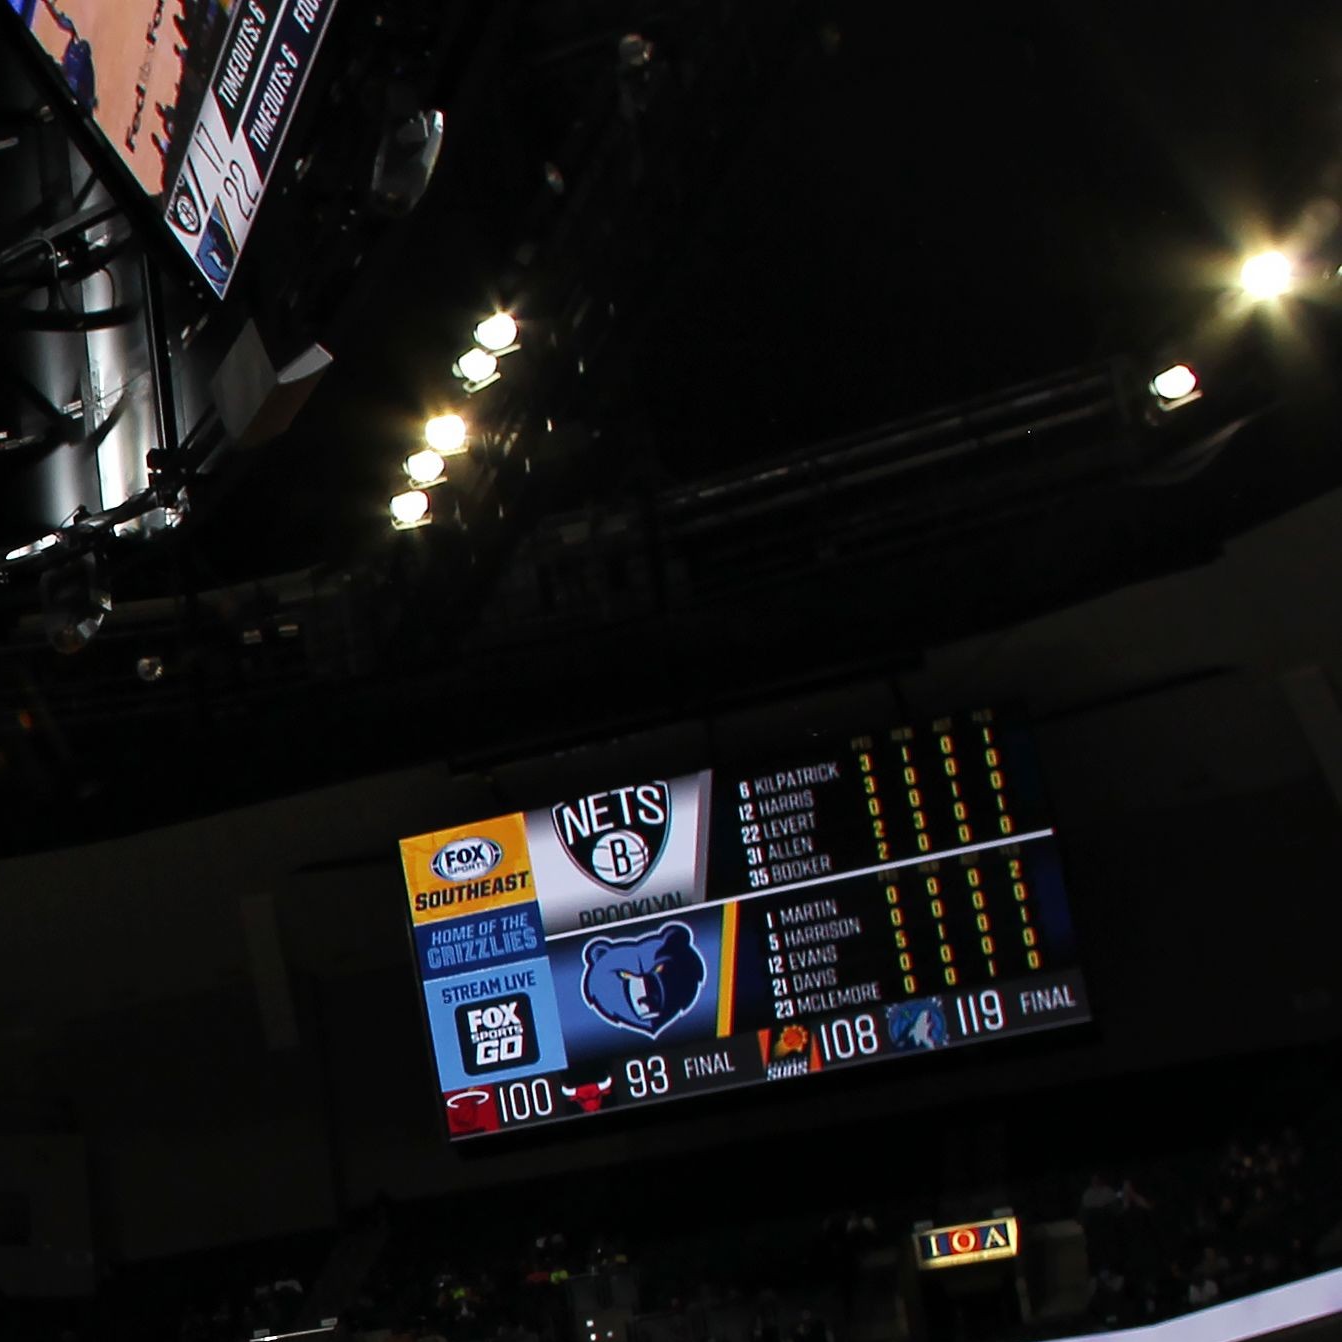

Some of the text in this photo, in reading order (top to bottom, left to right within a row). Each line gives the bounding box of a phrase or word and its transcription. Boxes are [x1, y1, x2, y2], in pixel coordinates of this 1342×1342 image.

[218, 0, 267, 109] TIMEOUTS: 6
[248, 44, 300, 152] TIMEOUTS: 6
[223, 159, 260, 222] 22
[754, 761, 842, 796] KILPATRICK
[561, 784, 665, 846] NETS
[738, 788, 816, 822] 12 HARRIS
[741, 811, 816, 845] 22 LEVERT
[443, 842, 486, 868] FOX
[609, 838, 632, 877] B
[746, 835, 814, 866] 31 ALLEN
[748, 854, 834, 889] 35 BOOKER
[414, 870, 530, 912] SOUTHEAST
[431, 912, 529, 947] HOME OF THE
[780, 898, 839, 927] MARTIN
[426, 926, 539, 970] GRIZZLIES
[769, 916, 863, 952] 5 HARRISON
[767, 943, 839, 975] 12 EVANS
[441, 969, 537, 1005] STREAM LIVE
[771, 966, 838, 998] 21 DAVIS
[466, 1001, 522, 1034] FOX
[774, 981, 882, 1020] 23 MCLEMORE
[954, 984, 1078, 1037] 119 FINAL
[470, 1025, 524, 1045] SPORTS
[475, 1034, 524, 1066] GO
[819, 1013, 880, 1063] 108
[624, 1051, 736, 1099] 93 FINAL
[498, 1077, 554, 1123] 100
